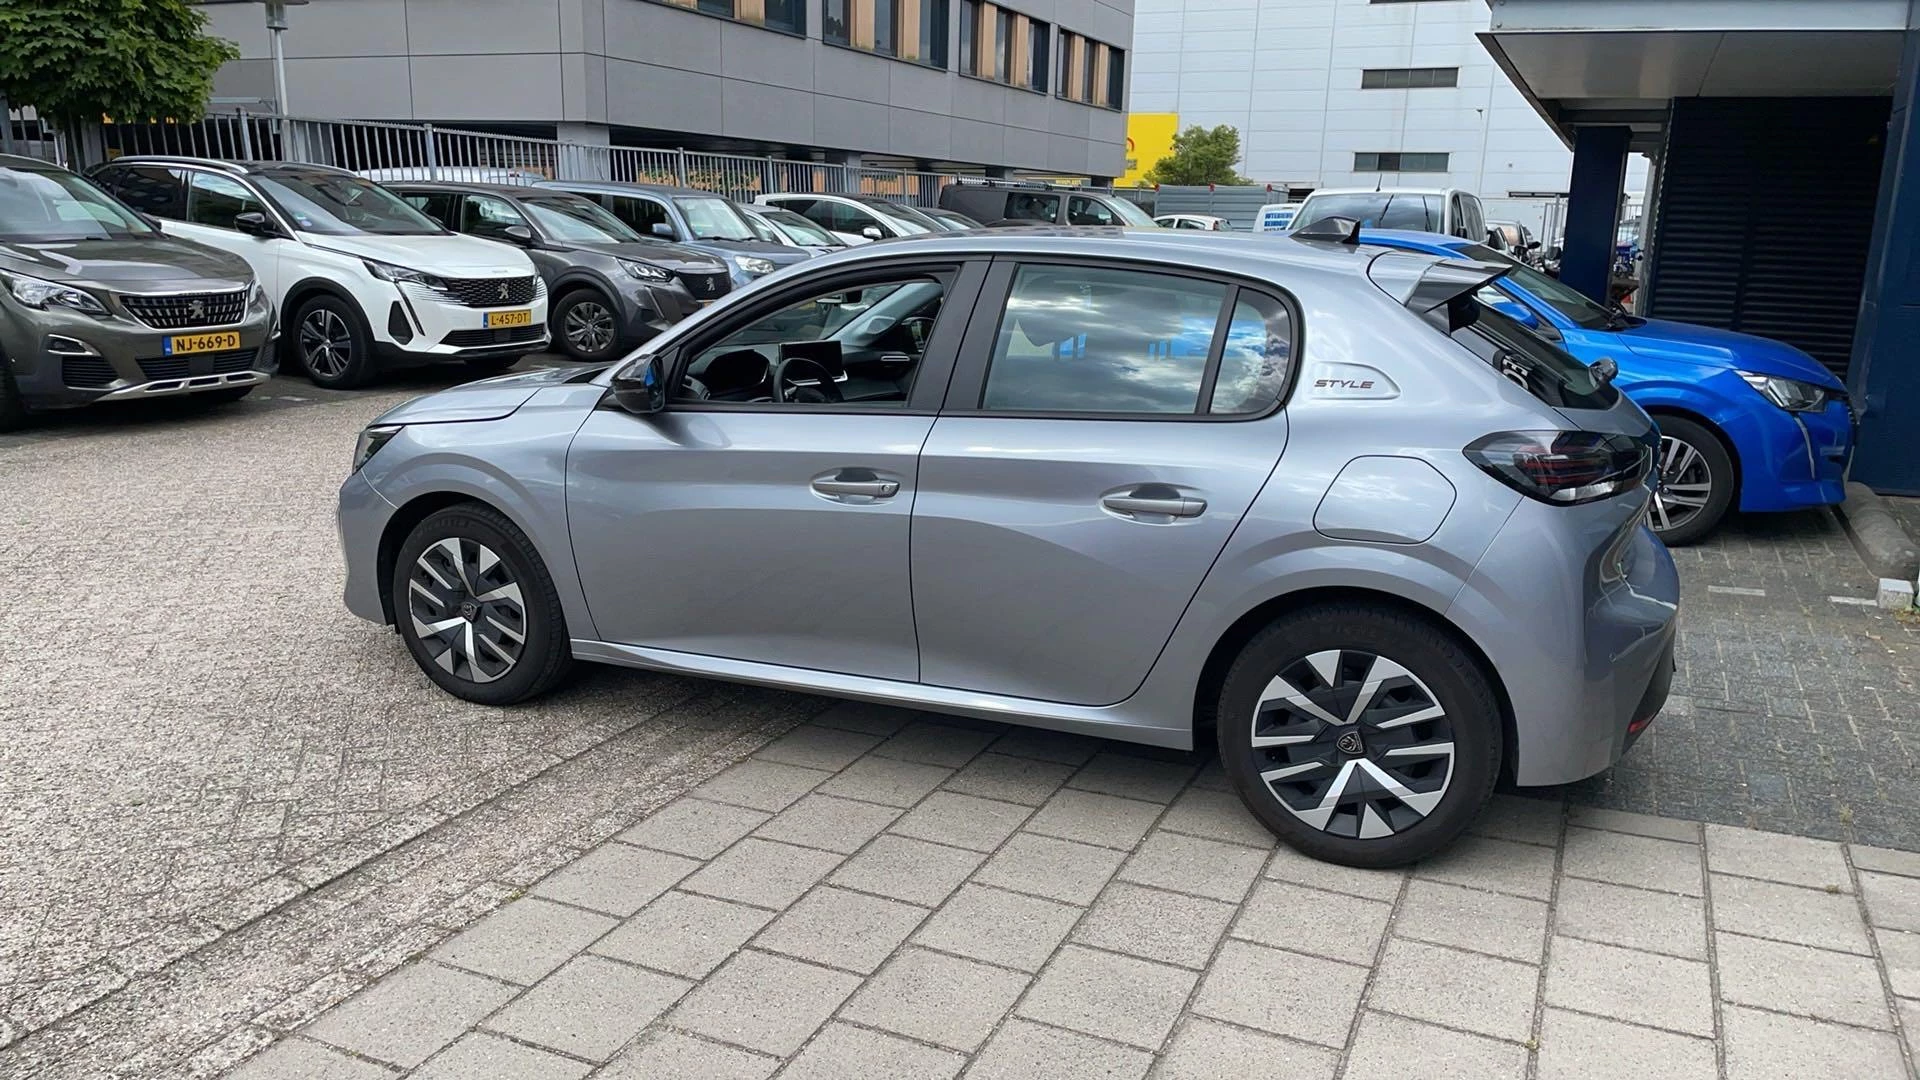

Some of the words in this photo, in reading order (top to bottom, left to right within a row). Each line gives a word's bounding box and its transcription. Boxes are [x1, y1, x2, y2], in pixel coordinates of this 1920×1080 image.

[491, 312, 529, 326] L-457-DT
[176, 335, 236, 352] NJ-669-D
[1314, 379, 1375, 389] STYLE
